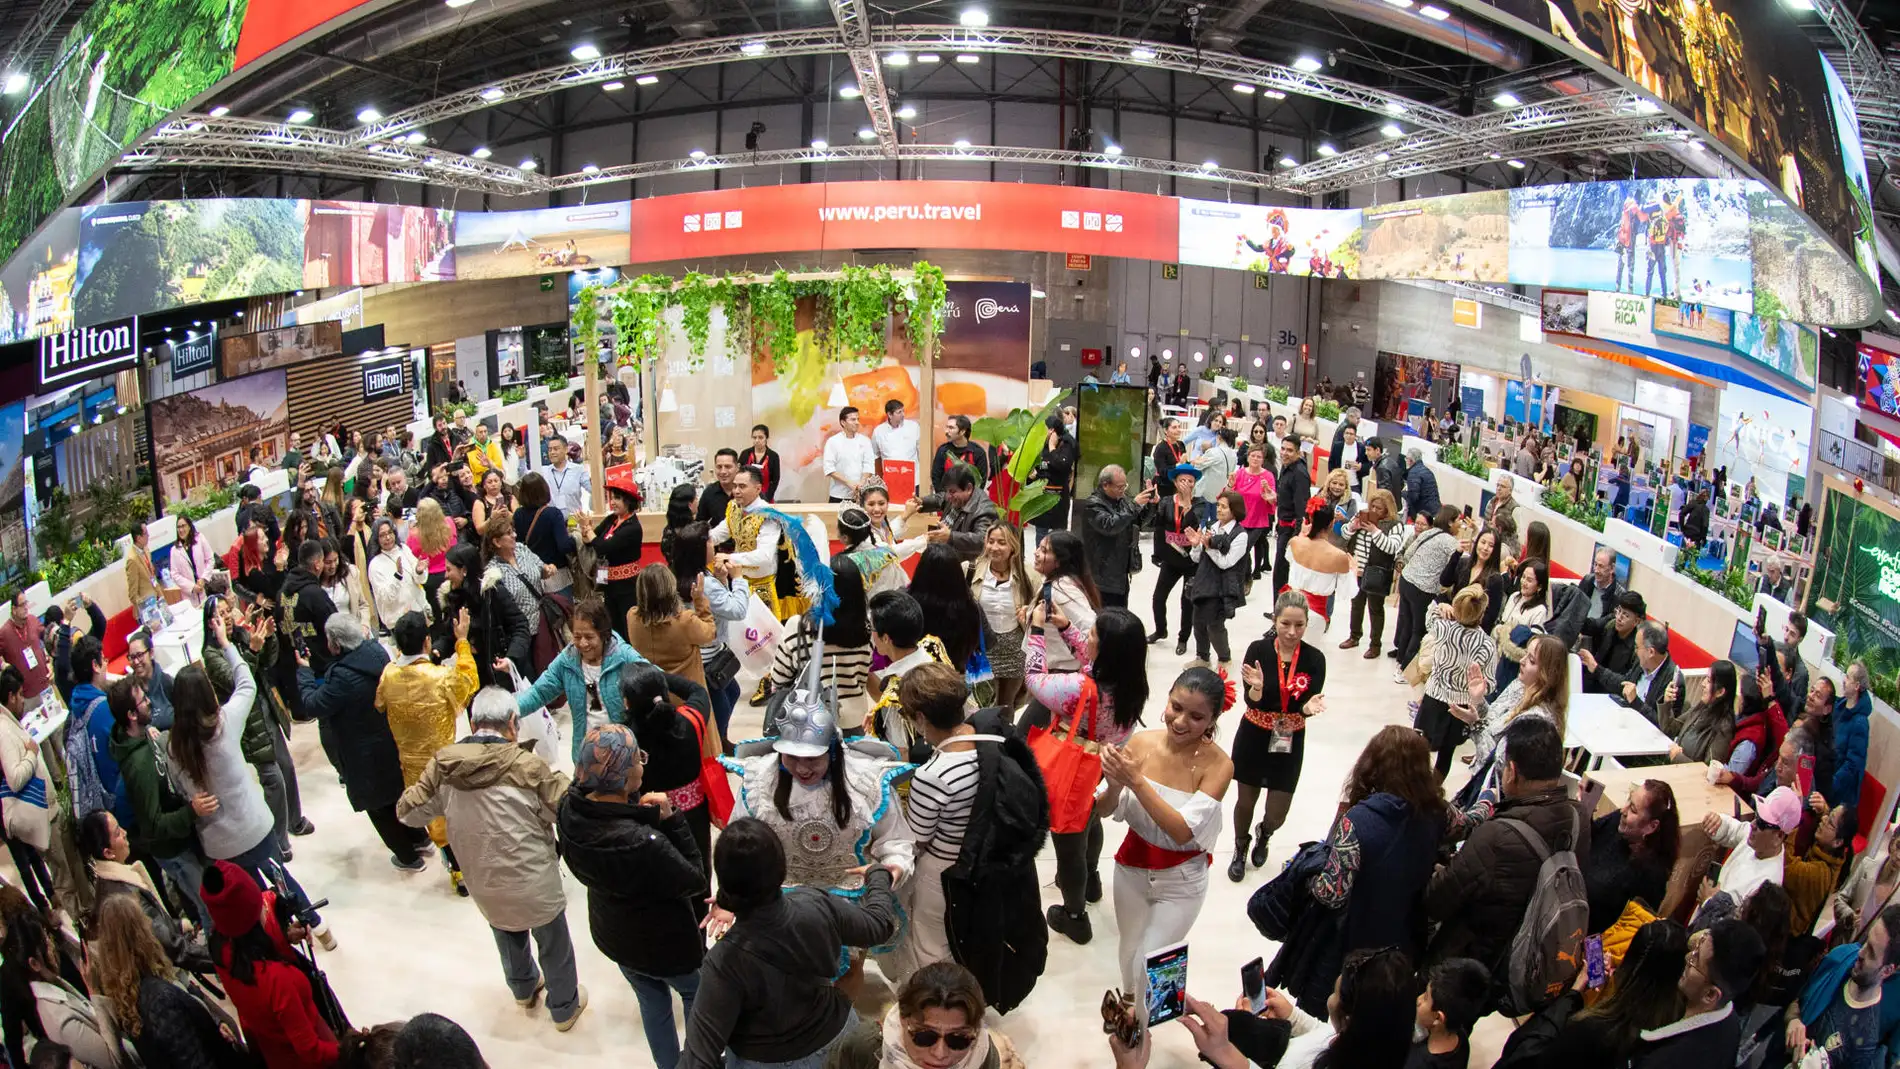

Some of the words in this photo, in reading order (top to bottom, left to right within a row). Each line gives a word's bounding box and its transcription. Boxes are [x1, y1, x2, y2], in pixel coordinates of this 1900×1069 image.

[818, 203, 982, 222] www.peru.travel
[941, 306, 961, 318] erú
[975, 297, 1020, 324] Perú
[1615, 298, 1646, 313] COSTA
[1614, 311, 1638, 326] RICA
[49, 325, 131, 369] Hilton
[1278, 330, 1297, 346] 3b
[176, 343, 209, 367] Hilton
[368, 372, 399, 391] Hilton
